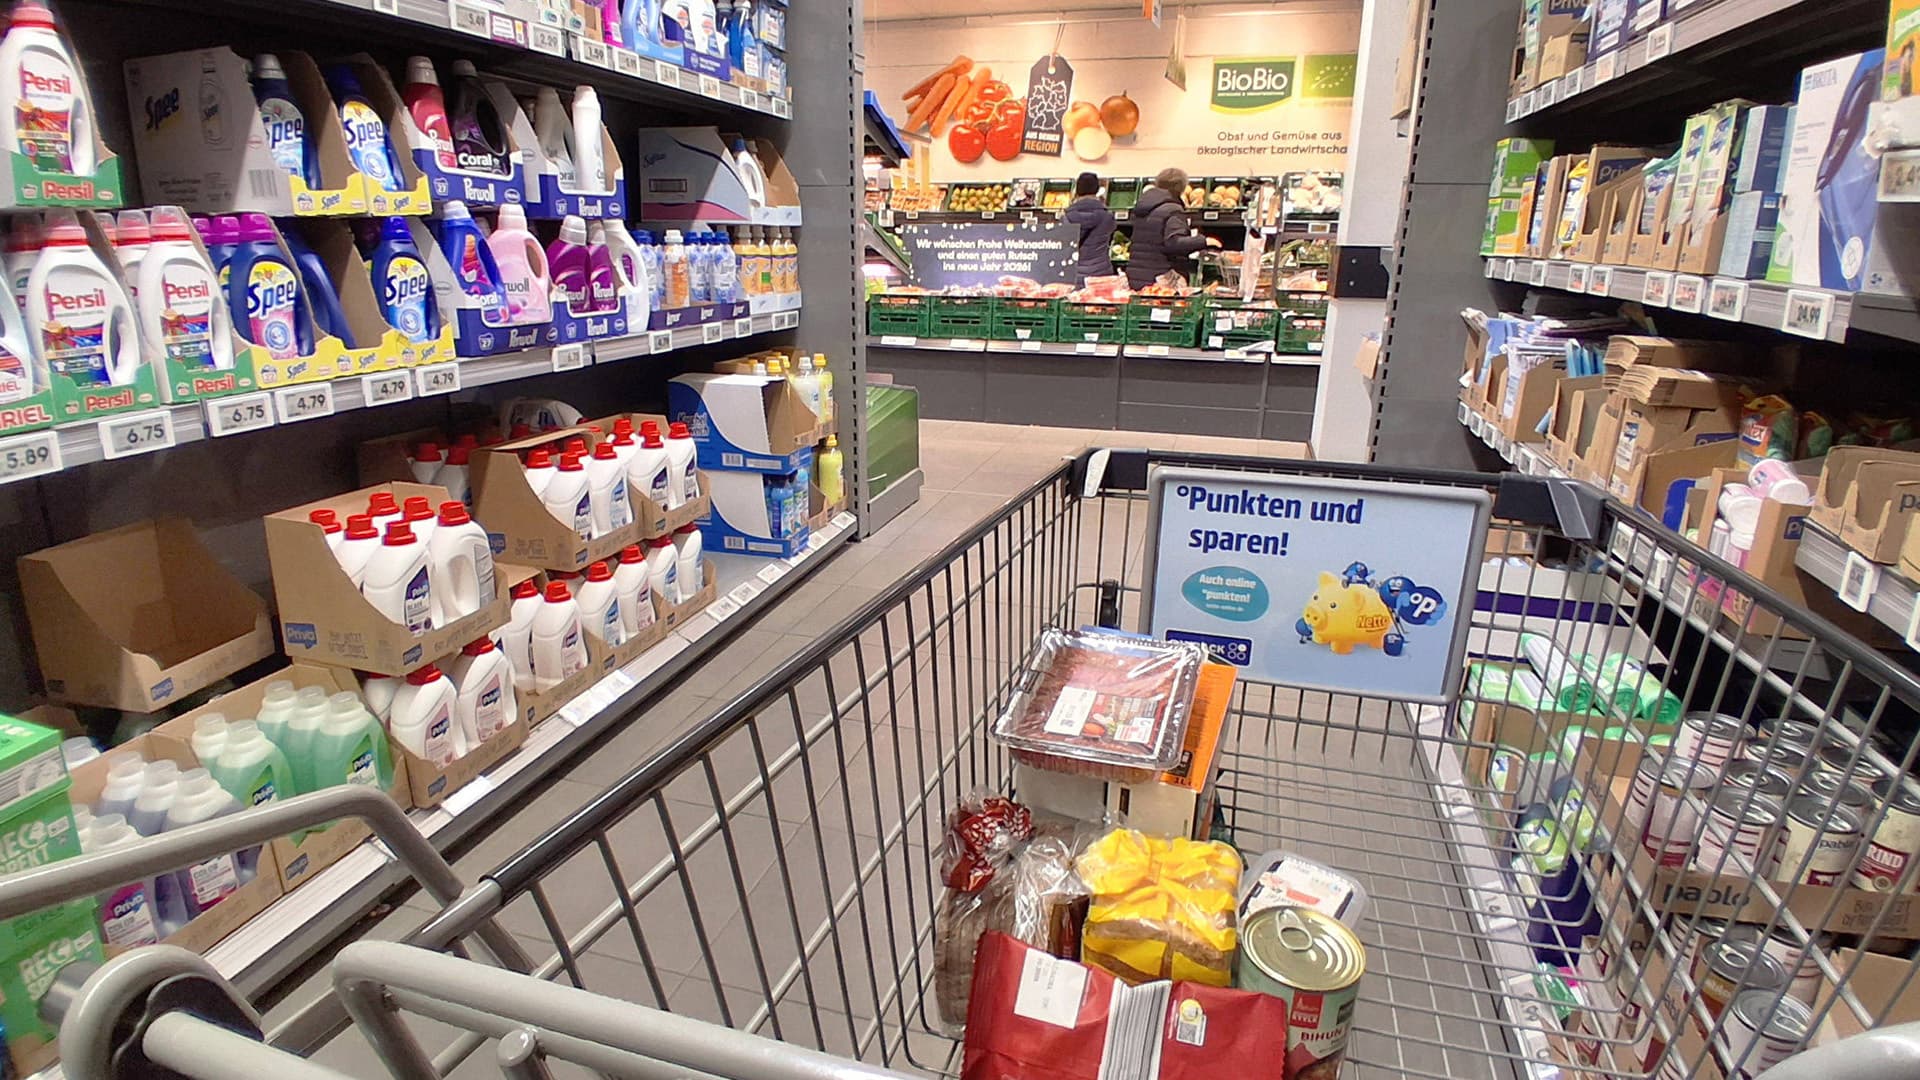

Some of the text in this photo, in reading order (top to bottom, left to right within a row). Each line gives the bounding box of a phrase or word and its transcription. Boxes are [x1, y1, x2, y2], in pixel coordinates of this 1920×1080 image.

[21, 70, 72, 94] Persil
[1217, 67, 1288, 91] BioBio
[145, 87, 180, 131] Spee
[345, 117, 385, 148] Spee
[1217, 131, 1343, 142] Obst und Gemüse aus
[1024, 140, 1059, 153] REGION
[1196, 146, 1268, 157] ökologischer
[458, 153, 493, 166] Coral
[44, 180, 95, 200] Persil
[463, 178, 496, 202] Perwoll
[916, 238, 1062, 250] Wir wünschen Frohe Weihnachten
[938, 251, 1038, 262] und einen guten Rutsch
[943, 262, 1032, 272] ins neue Jahr 2026!
[49, 288, 106, 310] Persil
[165, 280, 209, 299] Persil
[247, 280, 296, 317] Spee
[386, 274, 427, 305] Spee
[508, 328, 539, 348] Perwoll
[286, 361, 308, 380] Spee
[432, 372, 455, 386] 4.79
[194, 375, 236, 394] Persil
[380, 380, 406, 395] 4.79
[85, 390, 134, 411] Persil
[296, 394, 326, 411] 4.79
[0, 406, 52, 429] RIEL
[232, 405, 265, 423] 6.75
[127, 424, 165, 444] 6.75
[6, 447, 49, 470] 5.89
[1176, 485, 1364, 525] °Punkten und
[1188, 528, 1290, 557] sparen!
[1199, 574, 1257, 589] Auch online
[1356, 614, 1388, 629] Netto
